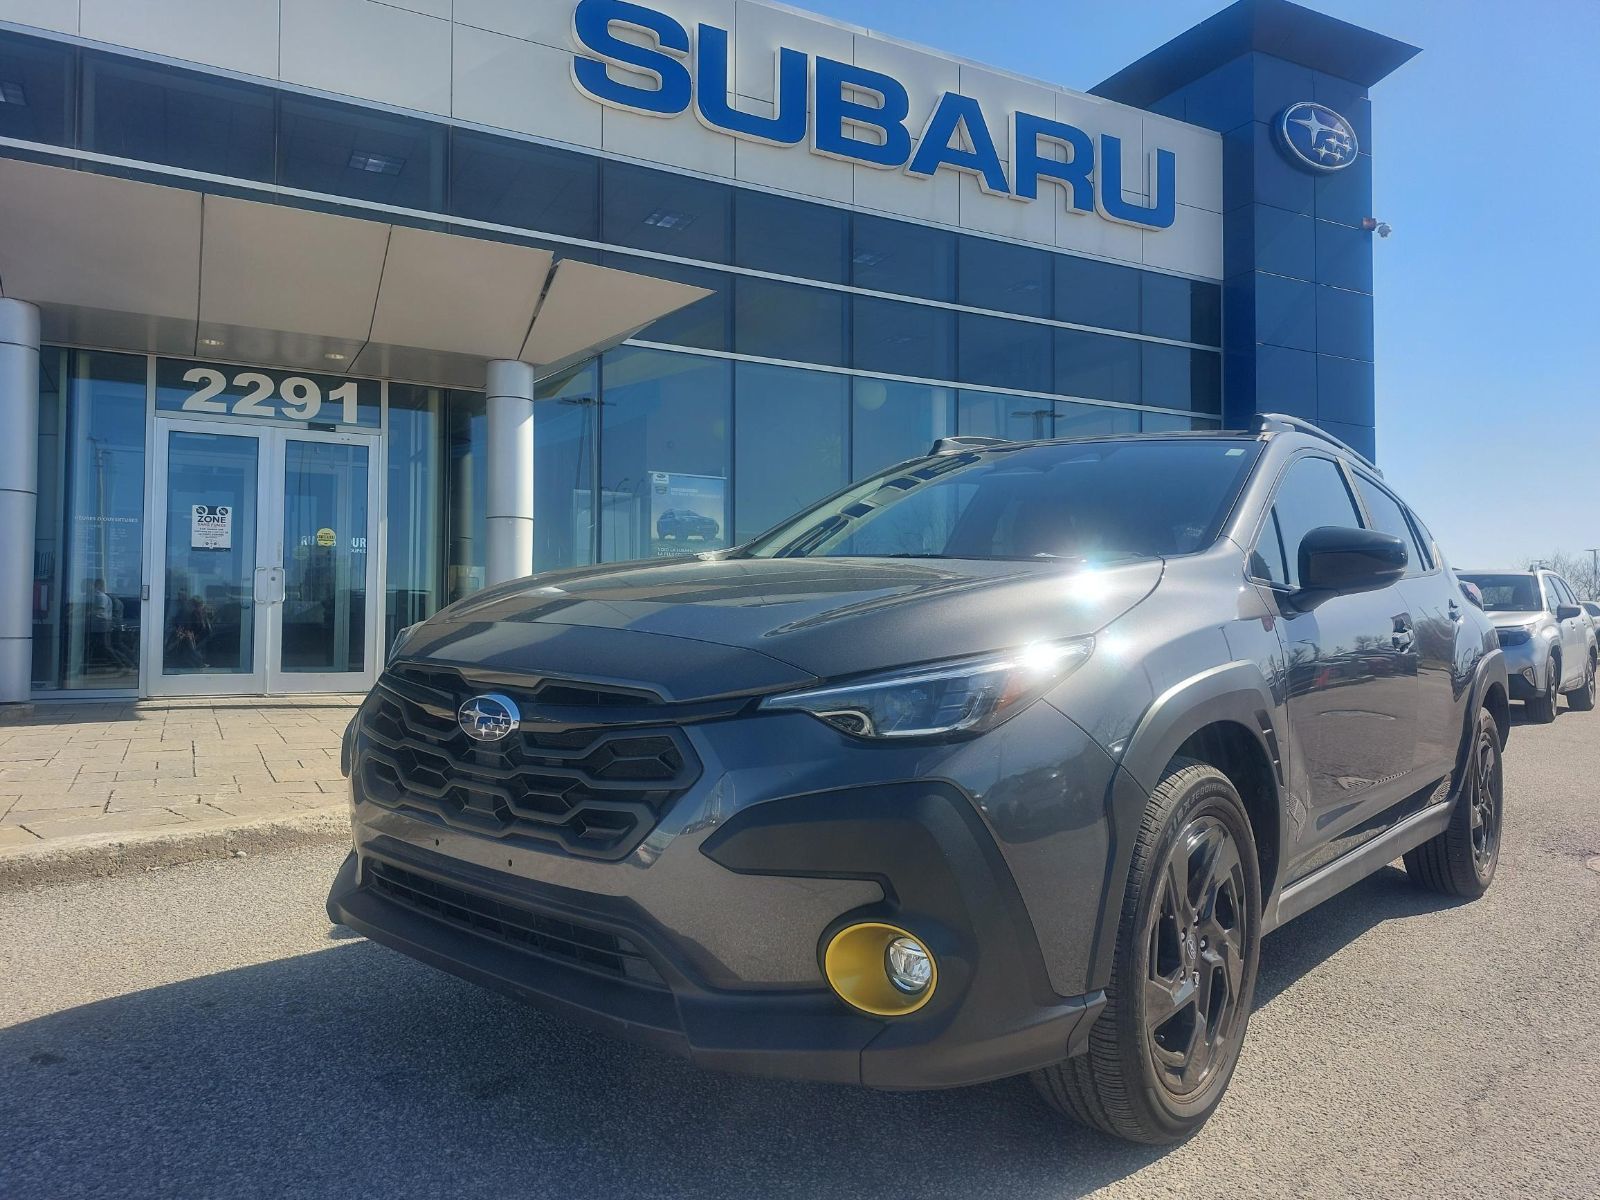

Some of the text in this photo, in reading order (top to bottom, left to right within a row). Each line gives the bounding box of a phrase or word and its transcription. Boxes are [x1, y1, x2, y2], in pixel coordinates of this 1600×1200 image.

[569, 0, 1176, 232] SUBARU
[181, 367, 358, 424] 2291
[197, 515, 227, 524] ZONE
